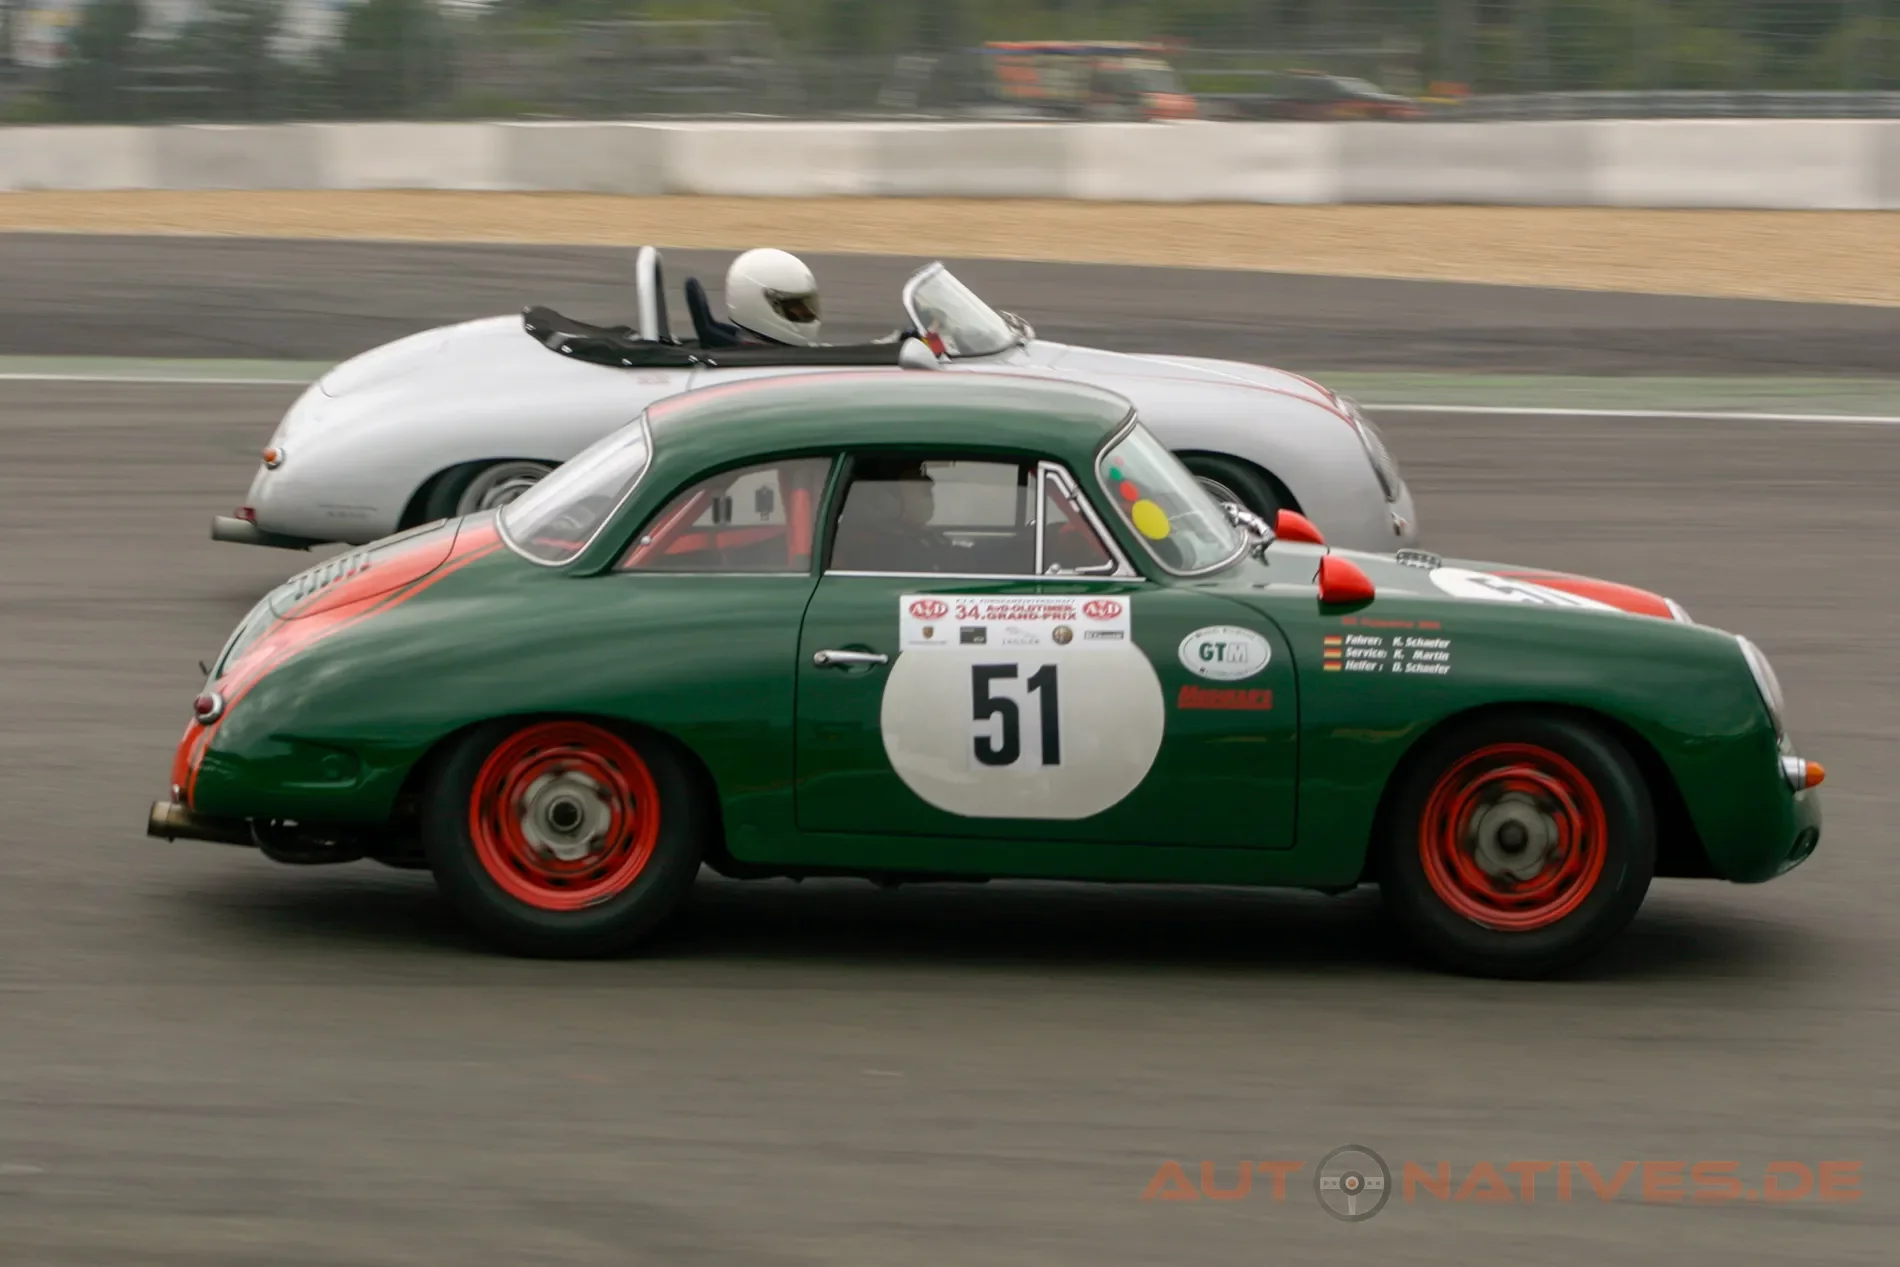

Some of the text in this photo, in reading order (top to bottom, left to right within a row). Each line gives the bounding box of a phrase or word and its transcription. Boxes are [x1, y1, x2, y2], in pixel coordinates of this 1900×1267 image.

[956, 605, 985, 620] 34.
[1405, 637, 1451, 648] Schaefer
[1199, 642, 1248, 663] GTM
[1412, 650, 1450, 661] Martin
[1405, 662, 1451, 674] Schaefer
[972, 663, 1061, 766] 51
